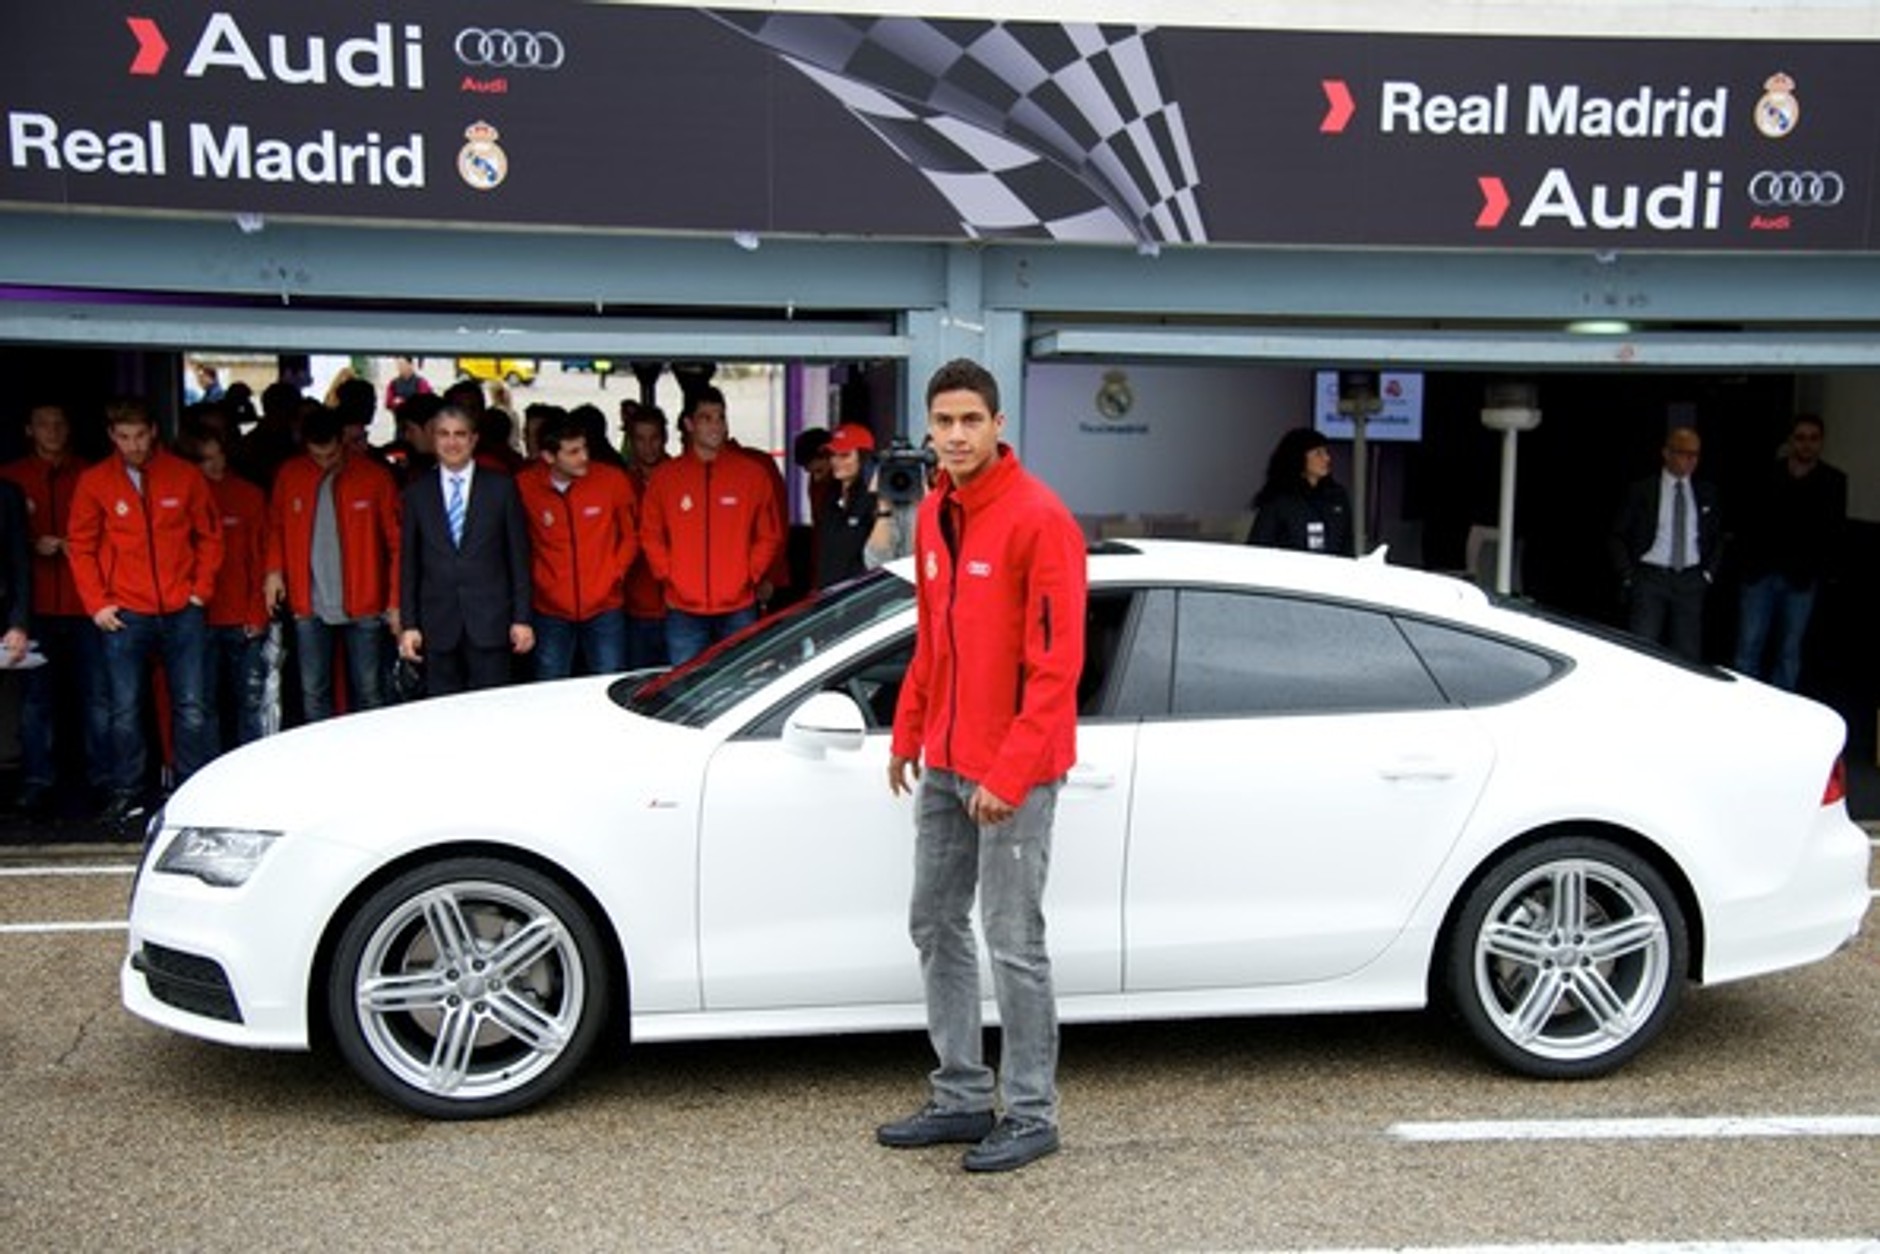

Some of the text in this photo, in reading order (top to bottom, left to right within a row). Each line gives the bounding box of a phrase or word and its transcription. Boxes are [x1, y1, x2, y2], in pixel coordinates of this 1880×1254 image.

[184, 12, 424, 90] Audi
[461, 76, 508, 93] Audi
[1381, 82, 1728, 138] Real Madrid
[8, 112, 425, 187] Real Madrid
[1519, 168, 1723, 230] Audi
[1750, 215, 1790, 230] Audi
